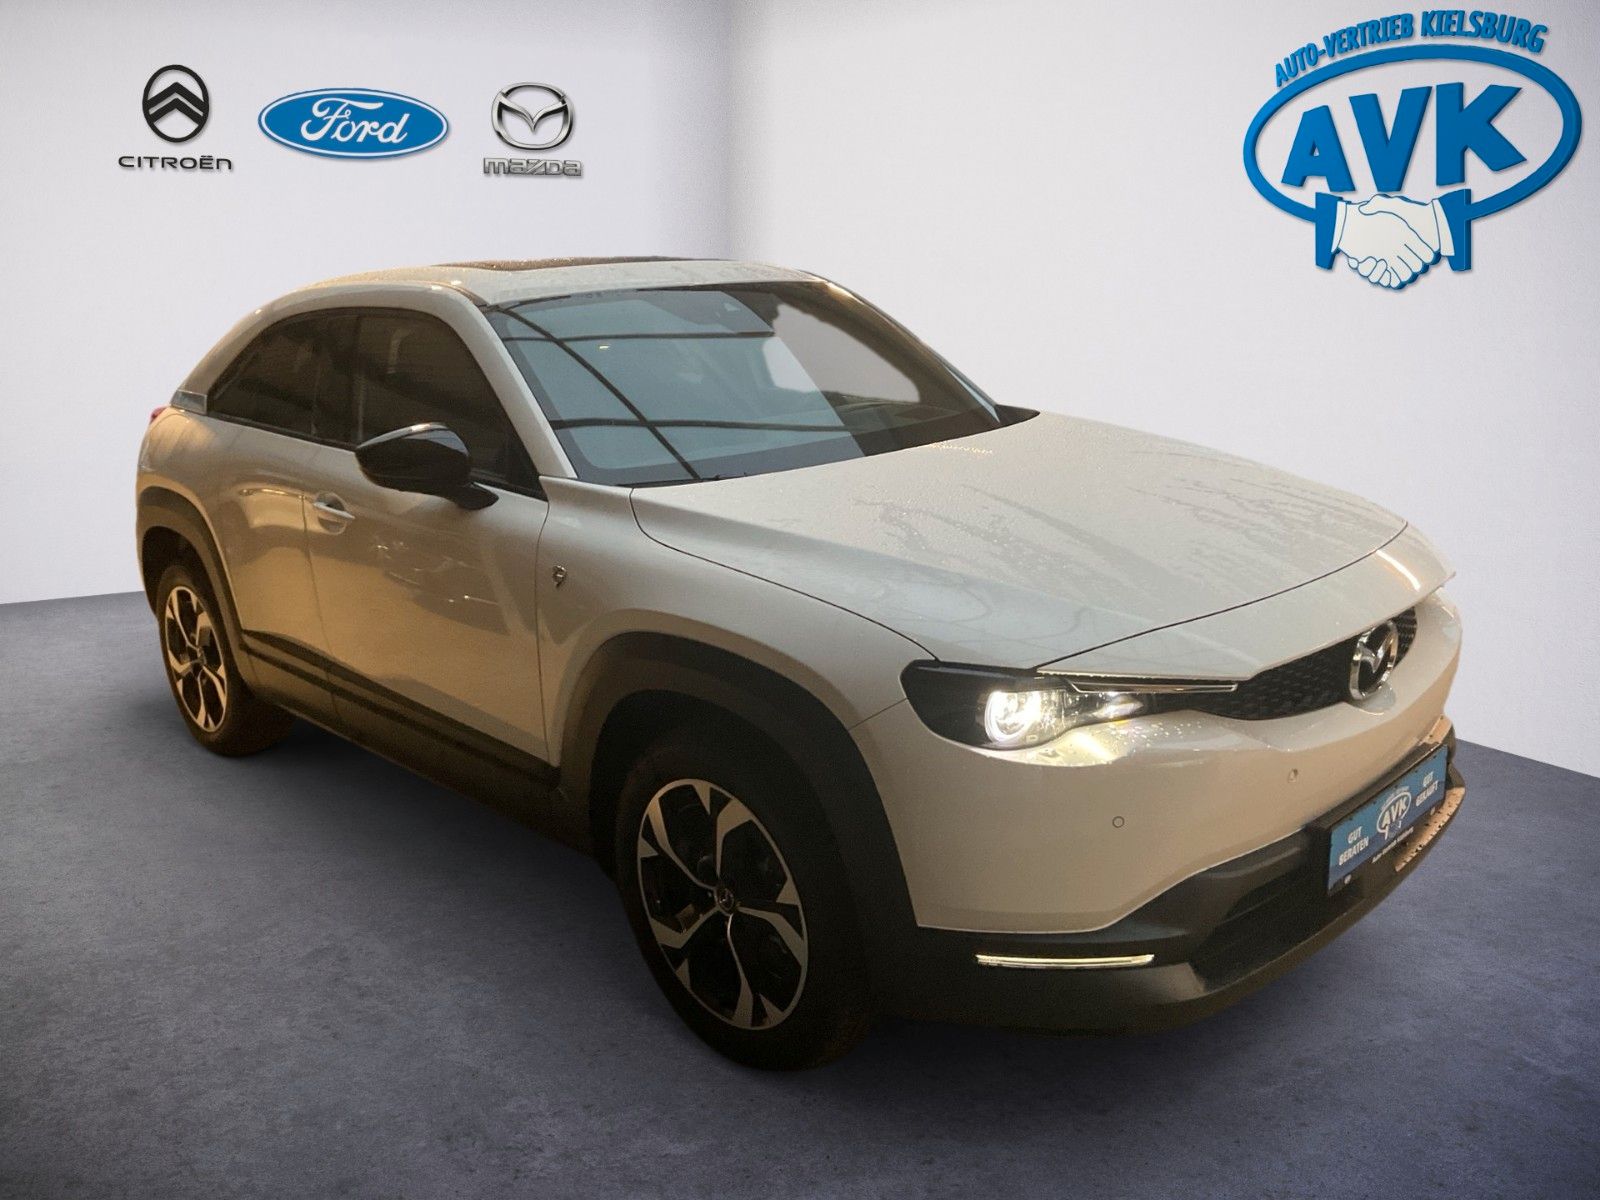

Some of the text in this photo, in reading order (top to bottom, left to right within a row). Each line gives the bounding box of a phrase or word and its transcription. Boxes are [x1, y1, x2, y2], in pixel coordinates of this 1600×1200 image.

[1381, 798, 1407, 829] AVK
[1347, 826, 1362, 844] GUT
[1338, 836, 1369, 866] BERATEN
